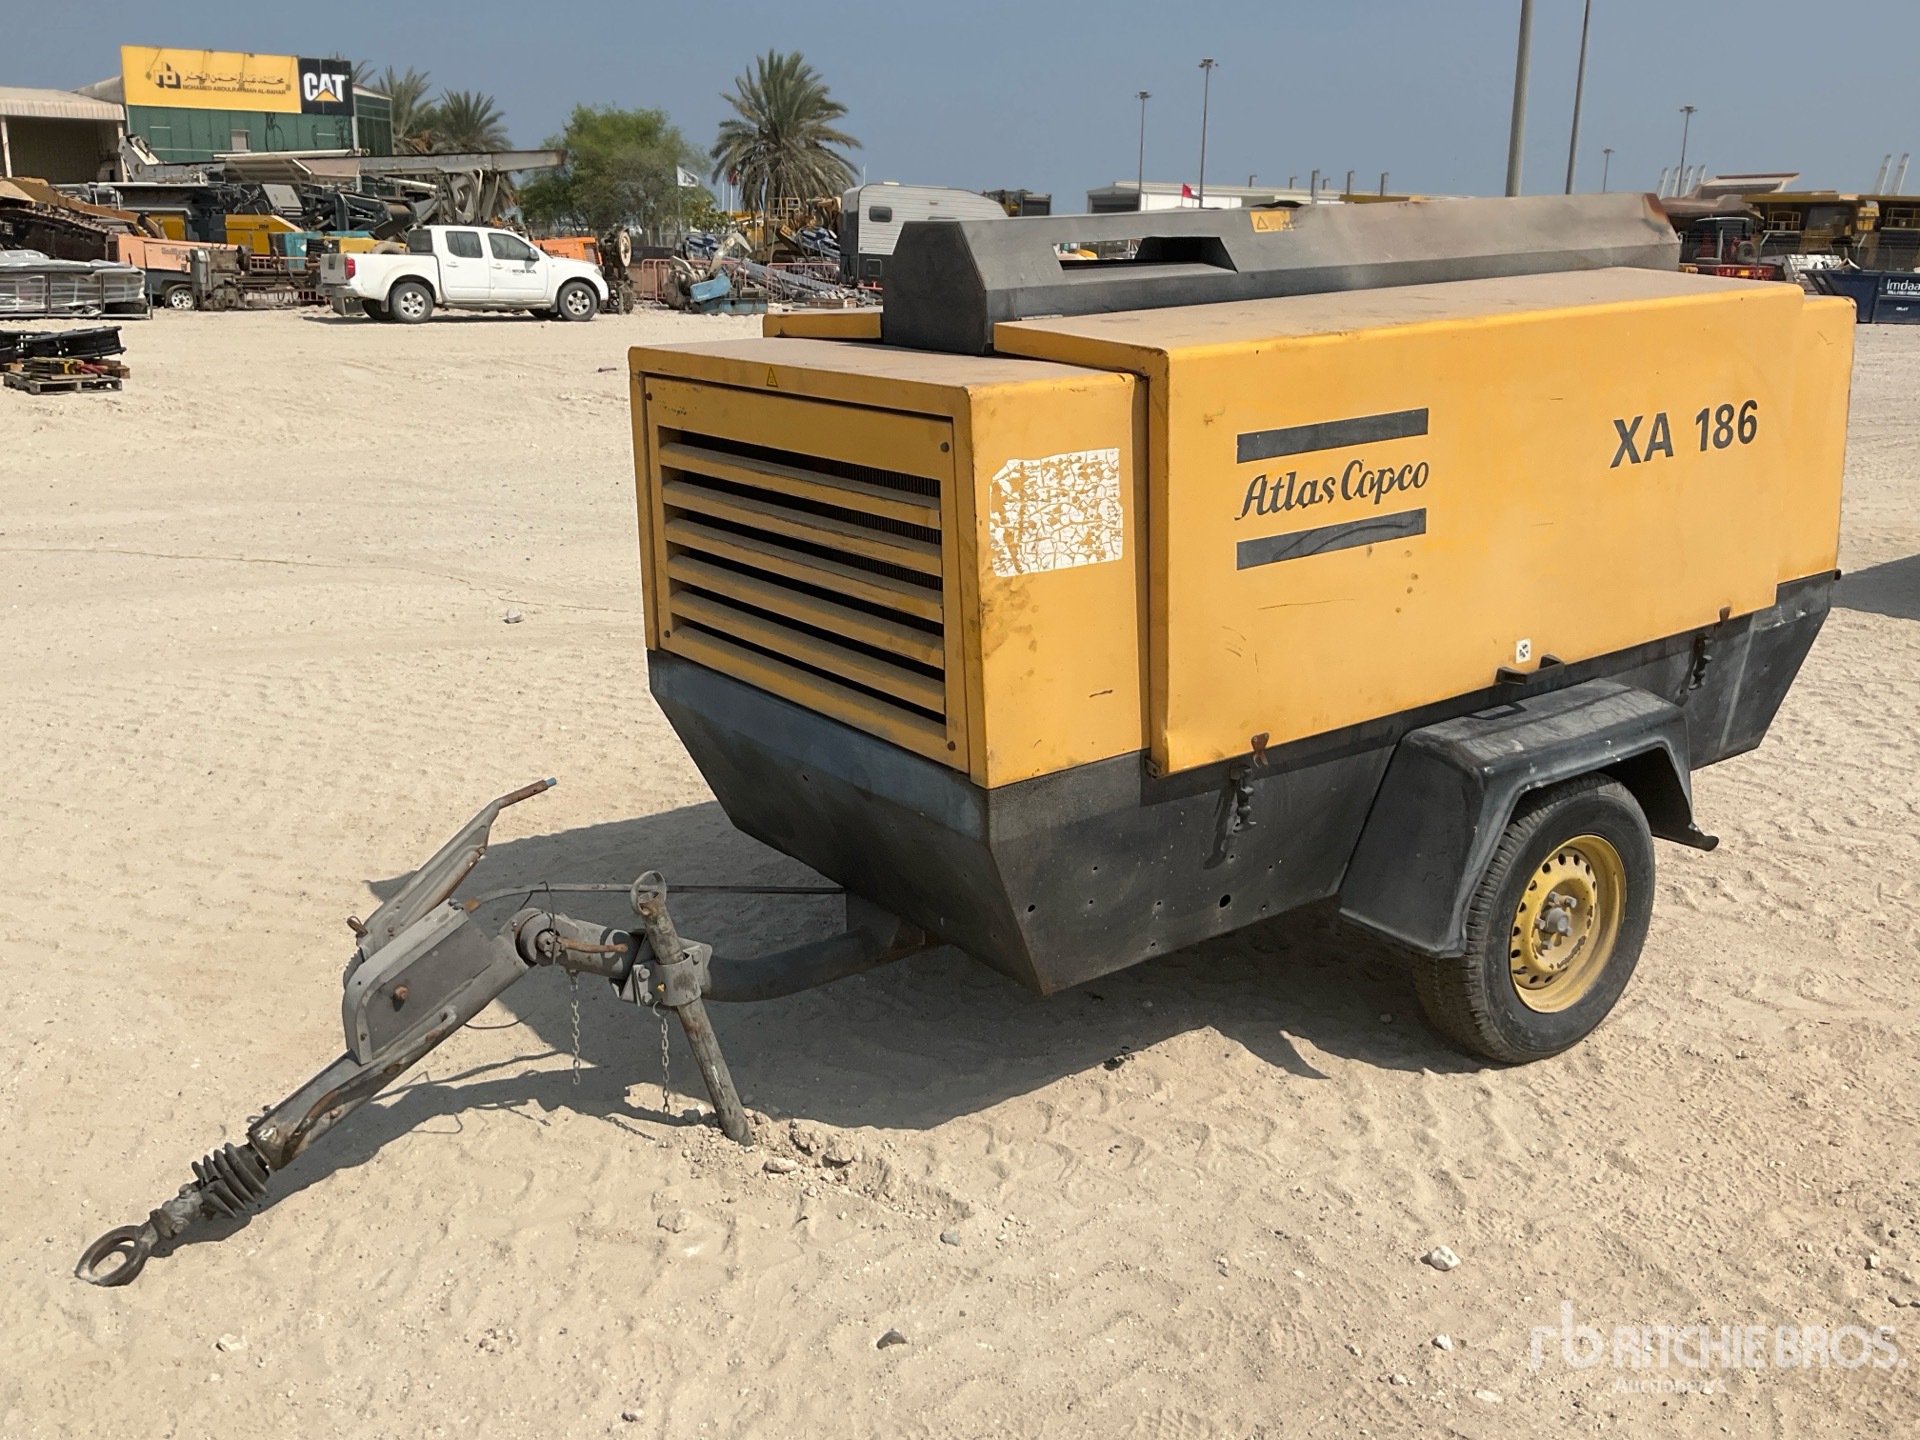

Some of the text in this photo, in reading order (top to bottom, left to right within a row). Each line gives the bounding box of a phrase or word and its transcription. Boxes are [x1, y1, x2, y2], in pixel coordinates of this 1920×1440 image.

[303, 72, 345, 102] CAT
[1609, 399, 1758, 469] XA 186
[1234, 459, 1429, 521] Atlas Copco
